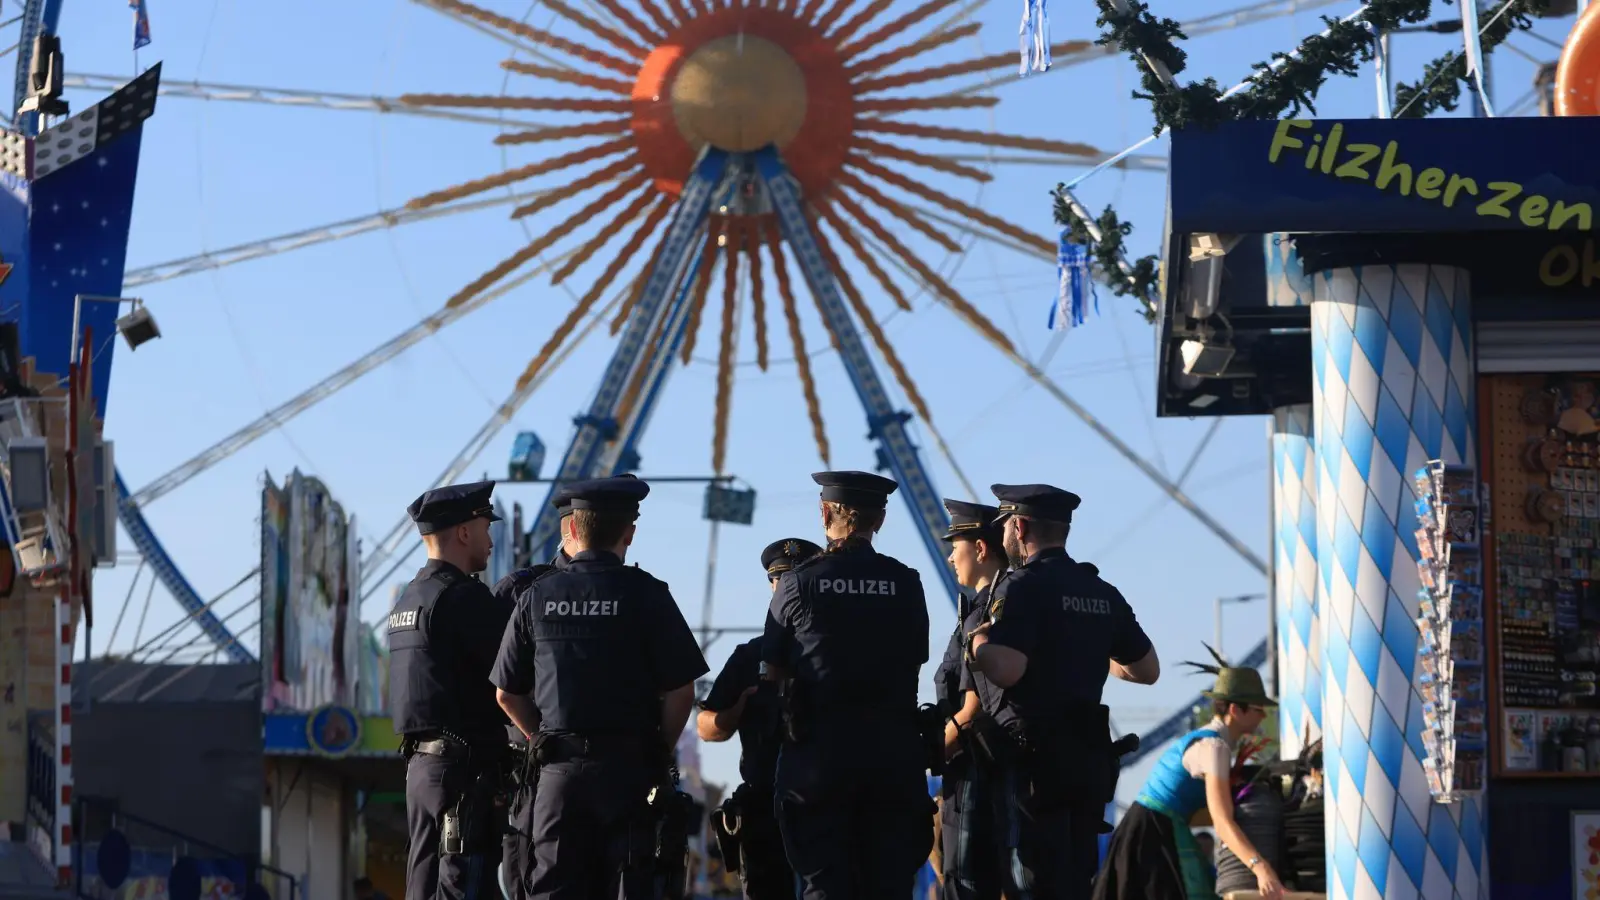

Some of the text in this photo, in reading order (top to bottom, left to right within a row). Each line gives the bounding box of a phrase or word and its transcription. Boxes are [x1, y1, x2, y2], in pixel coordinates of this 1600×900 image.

[1268, 118, 1593, 231] Filzherzen
[818, 578, 896, 596] POLIZEI
[544, 600, 618, 616] POLIZEI
[1062, 595, 1111, 615] POLIZEI
[388, 609, 418, 629] POLIZEI
